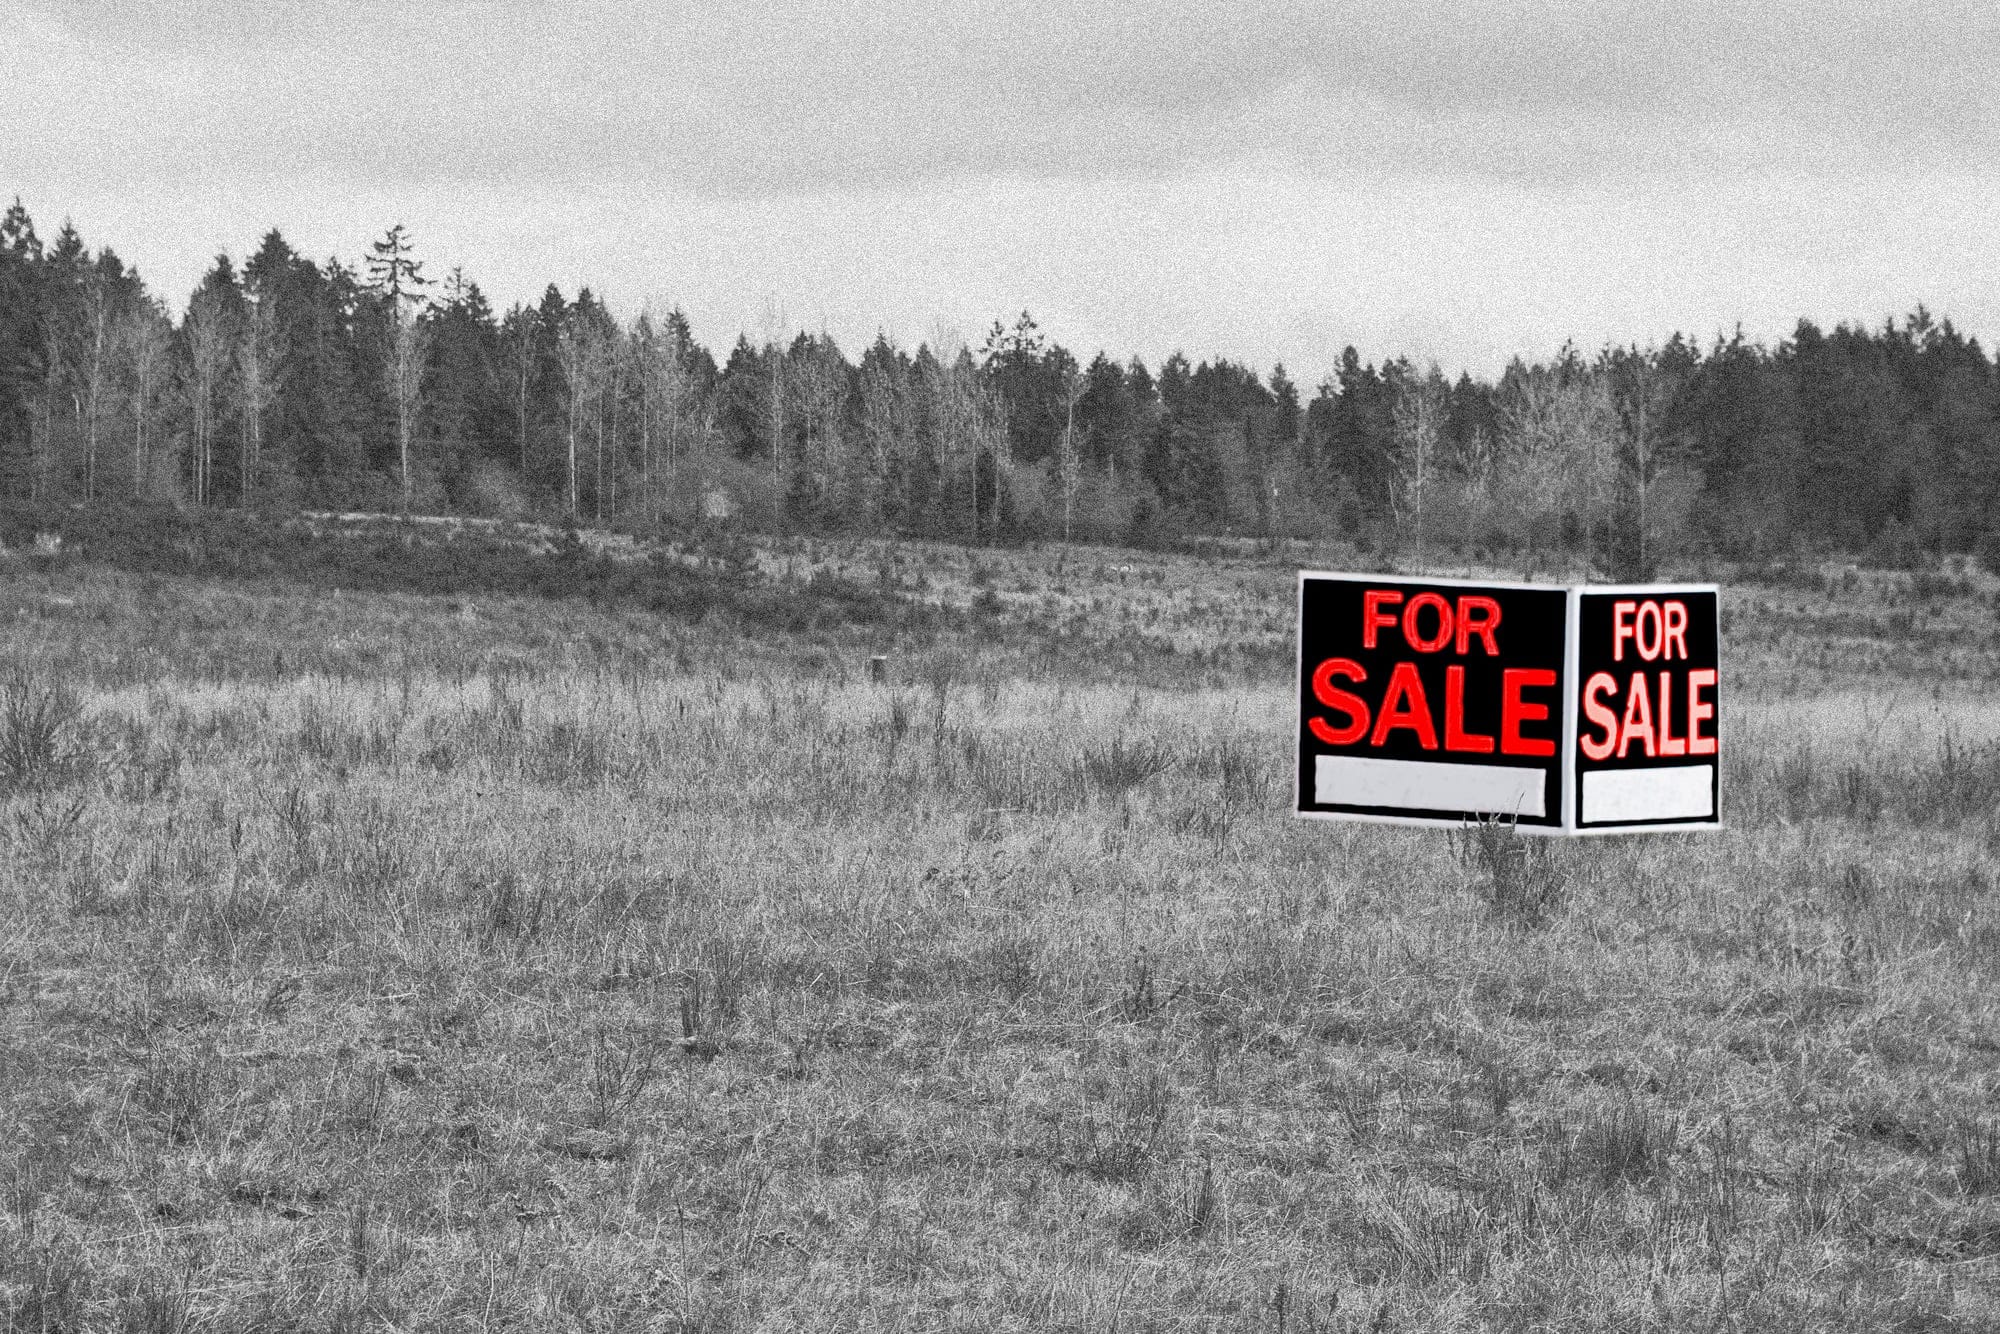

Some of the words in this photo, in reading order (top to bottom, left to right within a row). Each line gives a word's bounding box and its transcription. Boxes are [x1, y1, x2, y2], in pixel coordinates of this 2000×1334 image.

[1363, 589, 1502, 656] FOR
[1613, 600, 1689, 662] FOR
[1308, 657, 1557, 757] SALE
[1579, 668, 1719, 761] SALE
